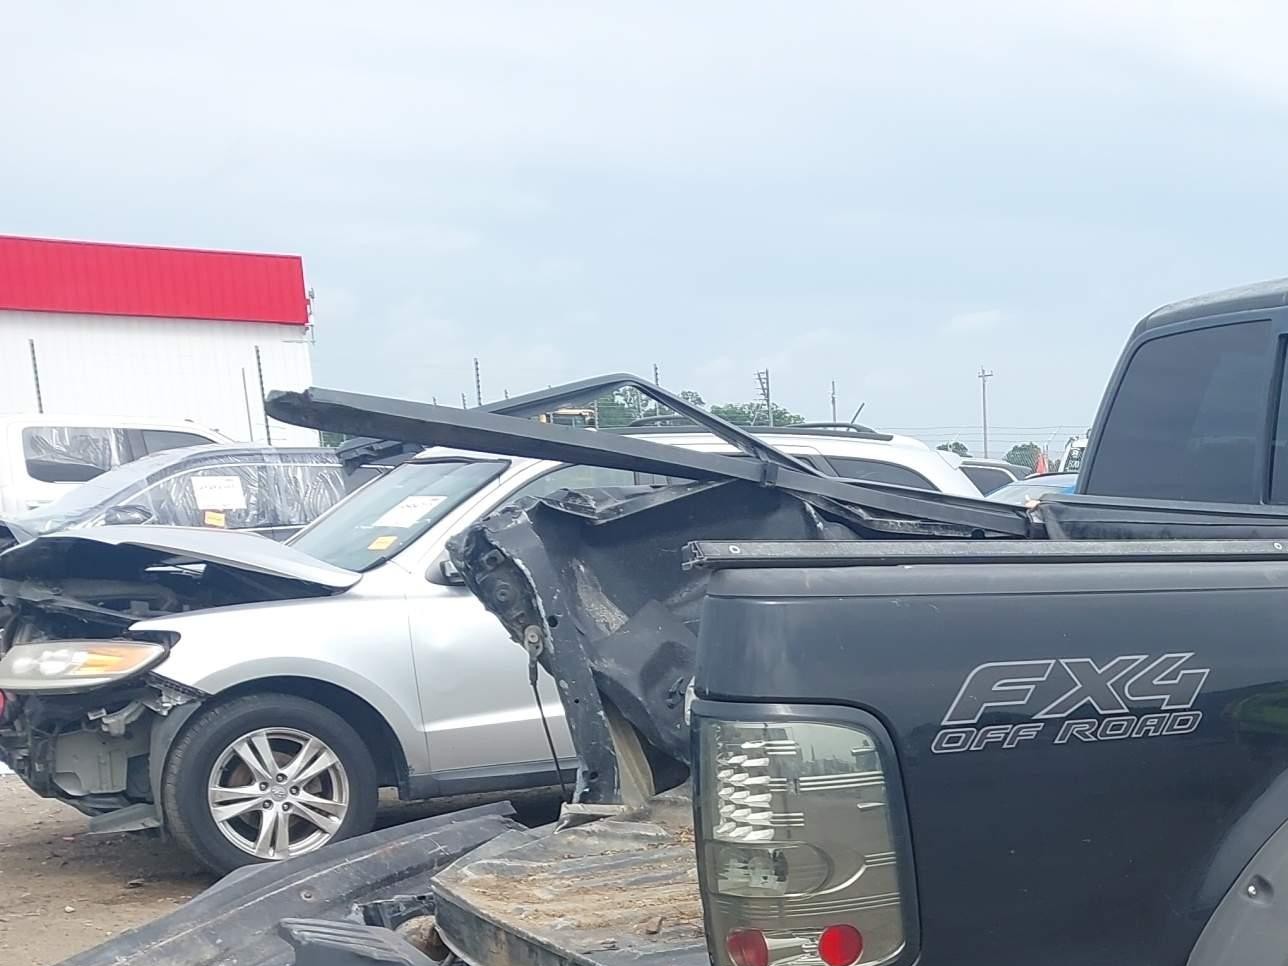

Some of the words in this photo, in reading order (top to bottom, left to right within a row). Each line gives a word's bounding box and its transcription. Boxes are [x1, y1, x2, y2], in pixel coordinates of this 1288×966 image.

[941, 652, 1210, 726] FX4
[930, 722, 1044, 754] OFF
[1053, 710, 1203, 745] ROAD
